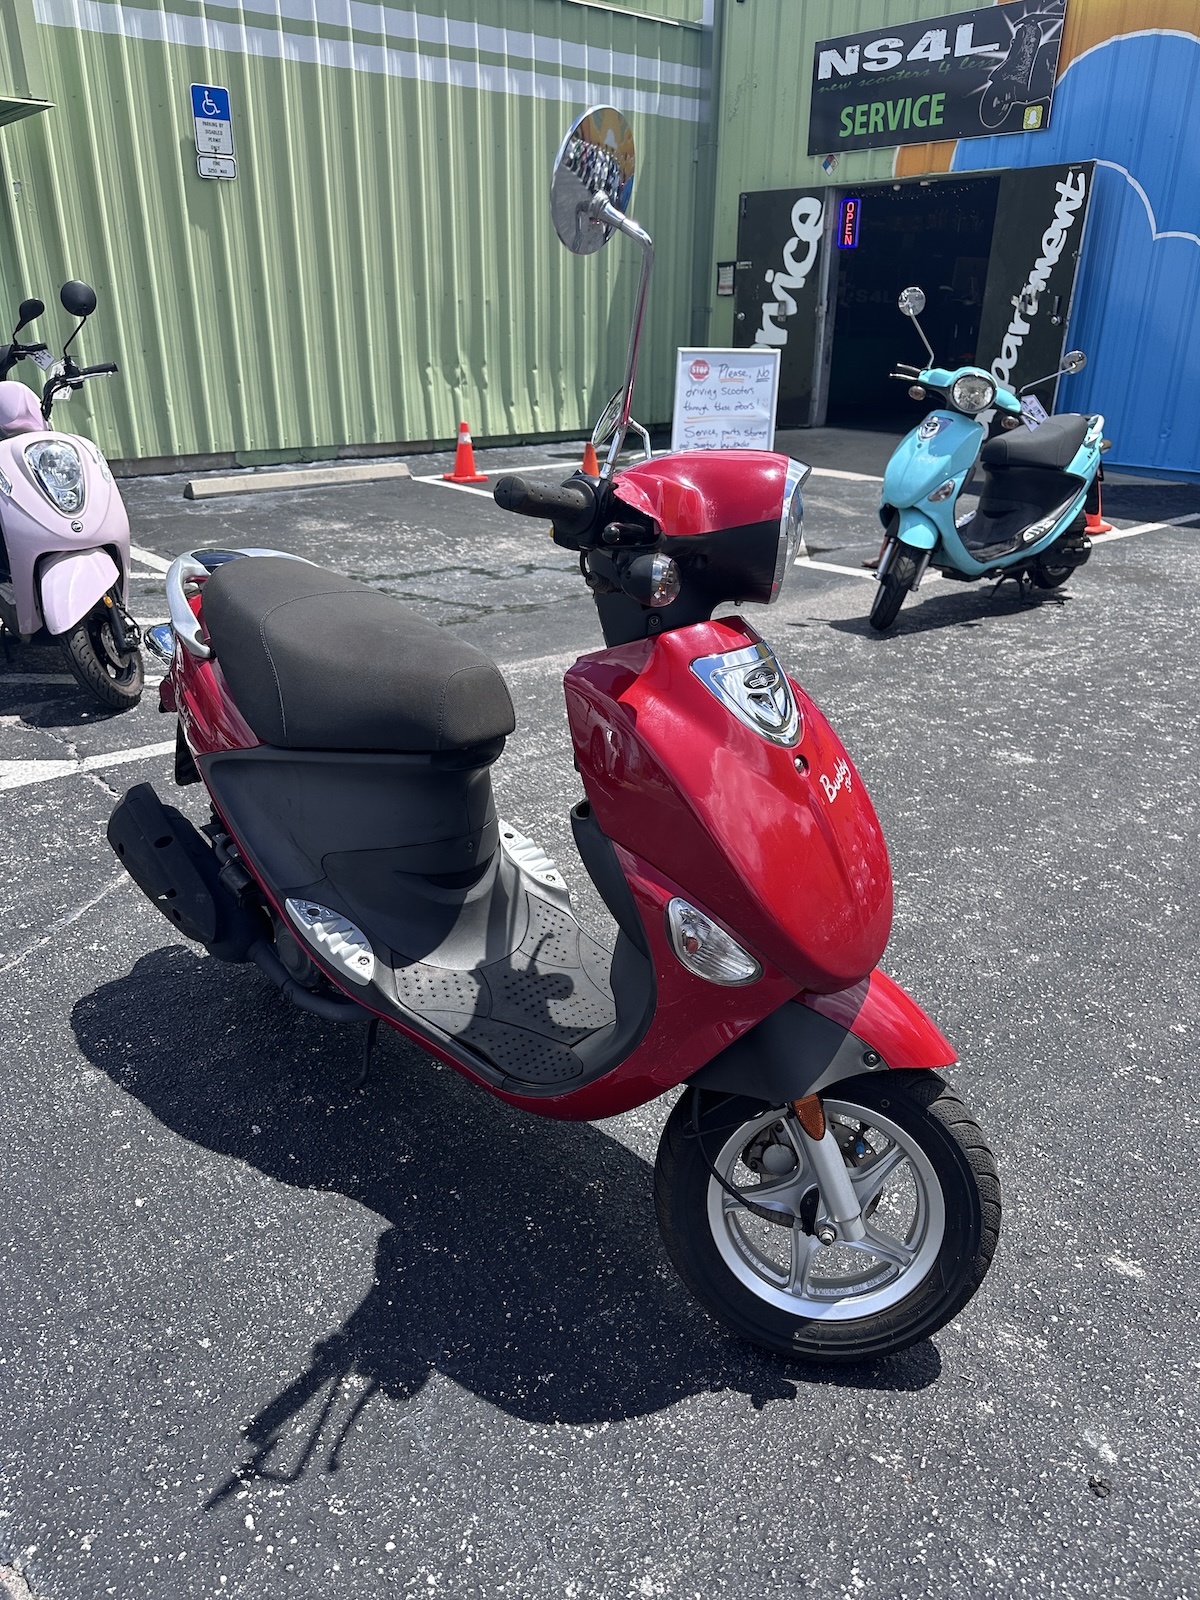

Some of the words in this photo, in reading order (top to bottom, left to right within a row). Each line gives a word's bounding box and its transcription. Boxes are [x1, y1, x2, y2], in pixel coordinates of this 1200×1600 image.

[818, 23, 1000, 80] NS4L
[817, 81, 851, 93] new
[857, 69, 931, 87] scooters
[939, 61, 951, 74] 4
[958, 56, 997, 70] less
[839, 93, 946, 138] SERVICE
[843, 202, 855, 245] OPEN
[750, 197, 826, 348] rvice
[691, 365, 709, 375] STOP
[718, 363, 751, 379] Please,
[756, 366, 770, 378] No
[683, 400, 709, 415] through
[714, 400, 731, 411] these
[686, 385, 717, 400] driving
[684, 425, 718, 439] Service,
[819, 756, 852, 803] Buddy
